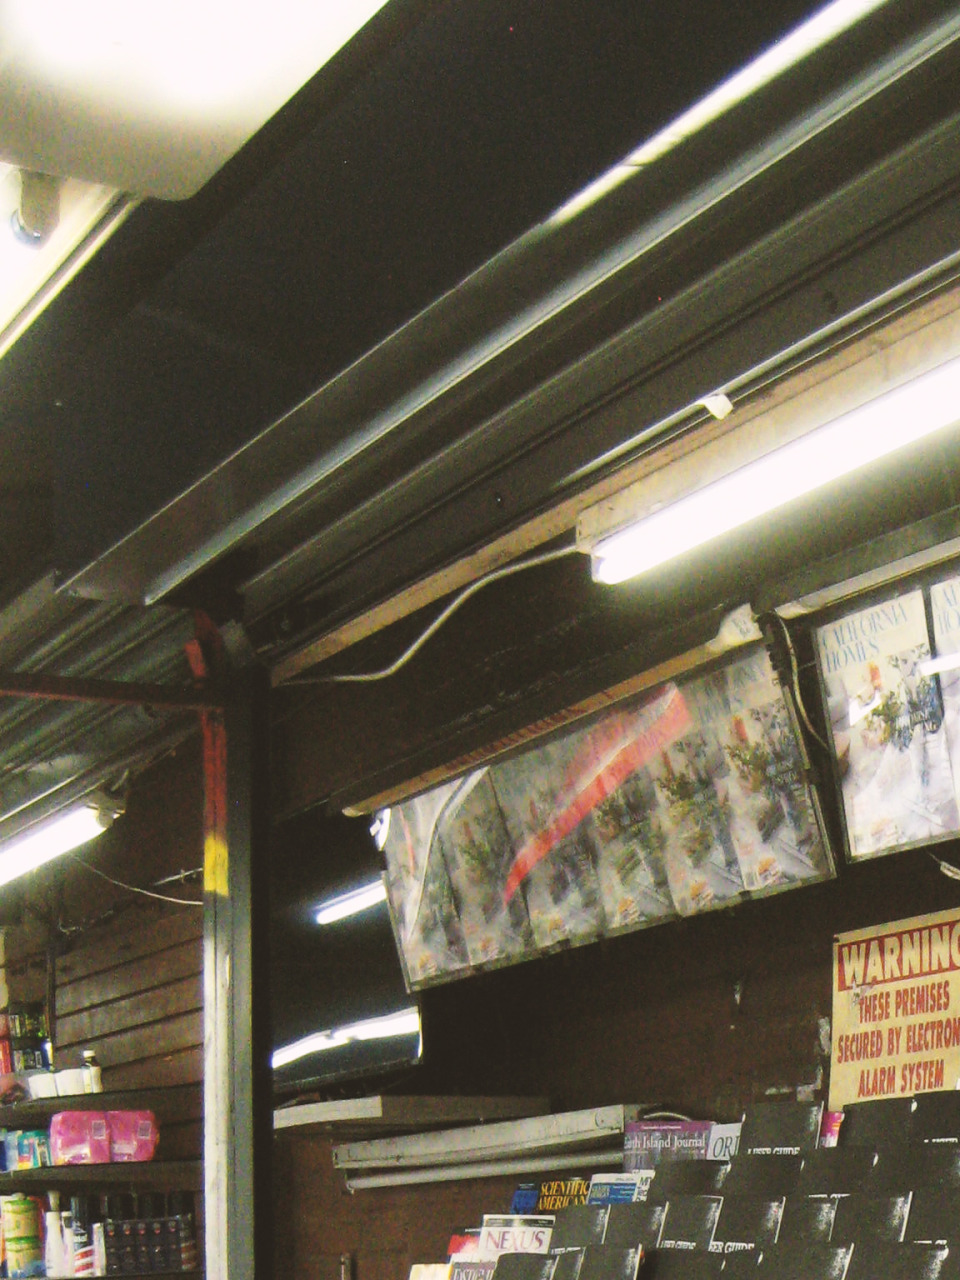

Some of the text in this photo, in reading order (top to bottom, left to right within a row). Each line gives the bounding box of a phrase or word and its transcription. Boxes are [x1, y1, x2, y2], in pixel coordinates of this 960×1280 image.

[859, 981, 950, 1023] THESE PREMISES
[837, 1029, 883, 1063] SECURED
[887, 1026, 902, 1056] BY
[858, 1060, 944, 1098] ALARM SYSTEM
[642, 1132, 706, 1150] Island Journal
[541, 1180, 589, 1196] SCIENTIFIC
[485, 1229, 546, 1252] NEXUS
